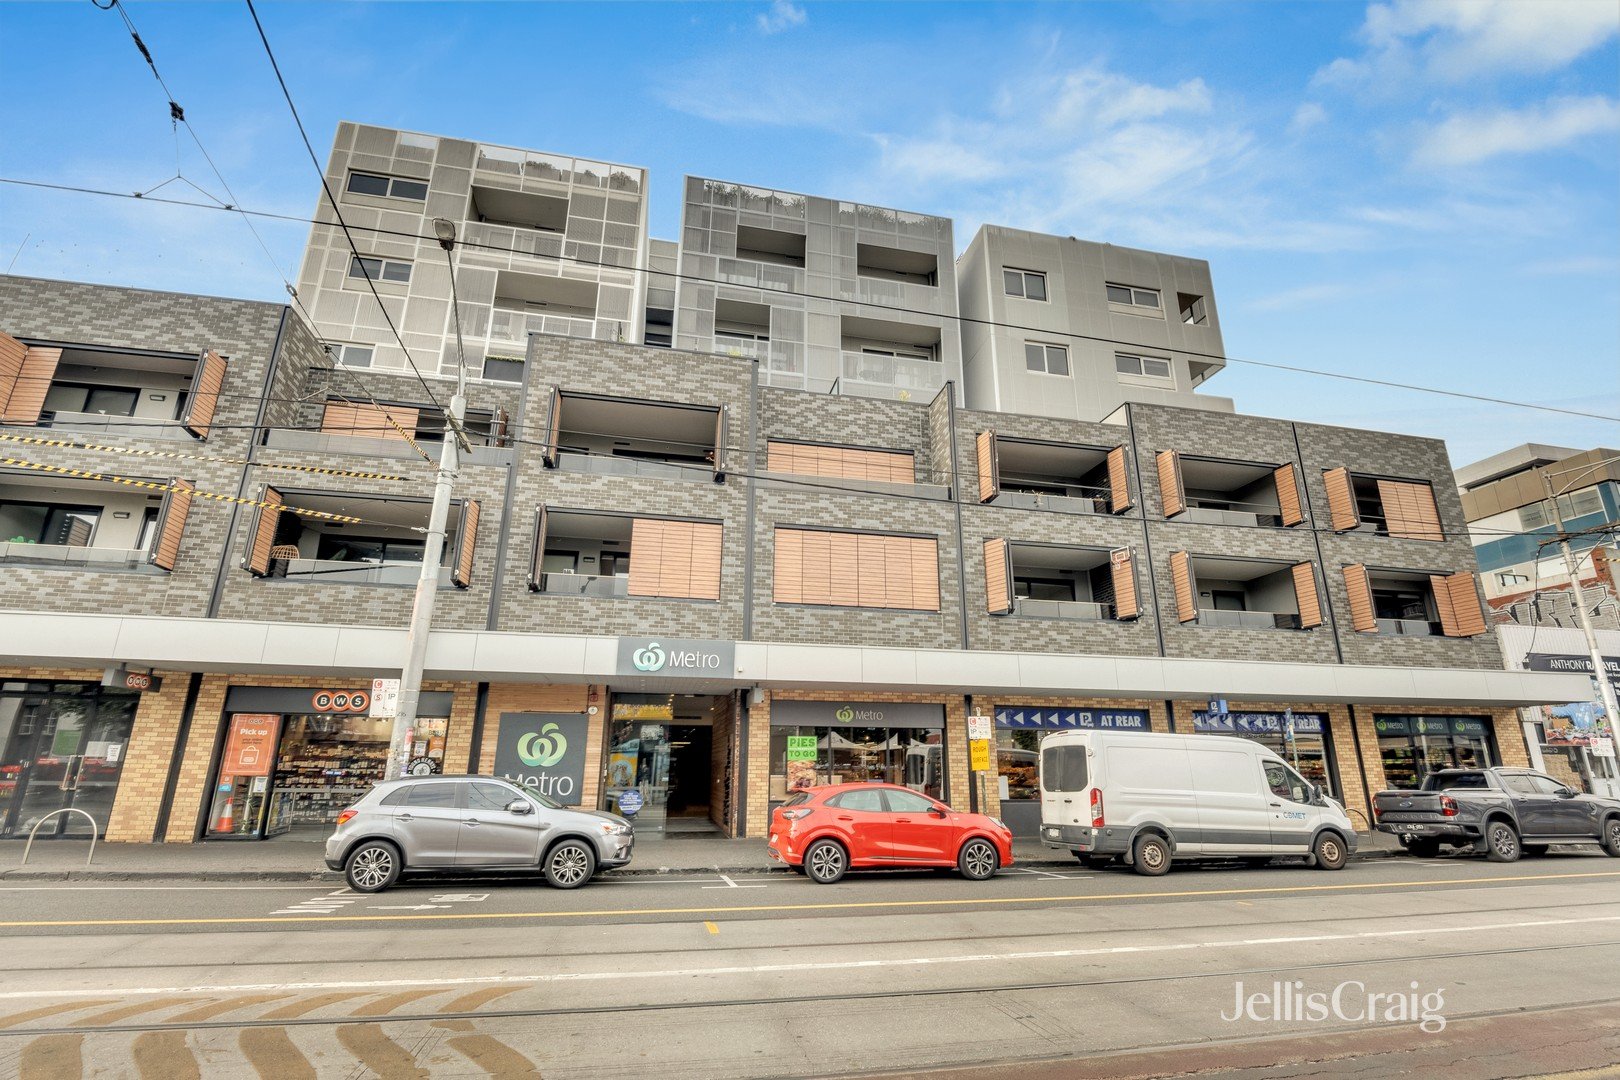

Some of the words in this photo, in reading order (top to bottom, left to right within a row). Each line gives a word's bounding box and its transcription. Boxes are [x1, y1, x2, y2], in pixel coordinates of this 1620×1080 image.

[669, 651, 720, 669] Metro
[1550, 659, 1585, 670] ANTHONY
[855, 710, 884, 720] Metro
[1100, 715, 1113, 726] AT
[1115, 715, 1142, 727] REAR
[1387, 720, 1404, 730] Metro
[1427, 721, 1443, 730] Metro
[1465, 722, 1481, 730] Metro
[240, 728, 257, 736] Pick
[257, 729, 268, 737] up
[789, 738, 816, 747] PIES
